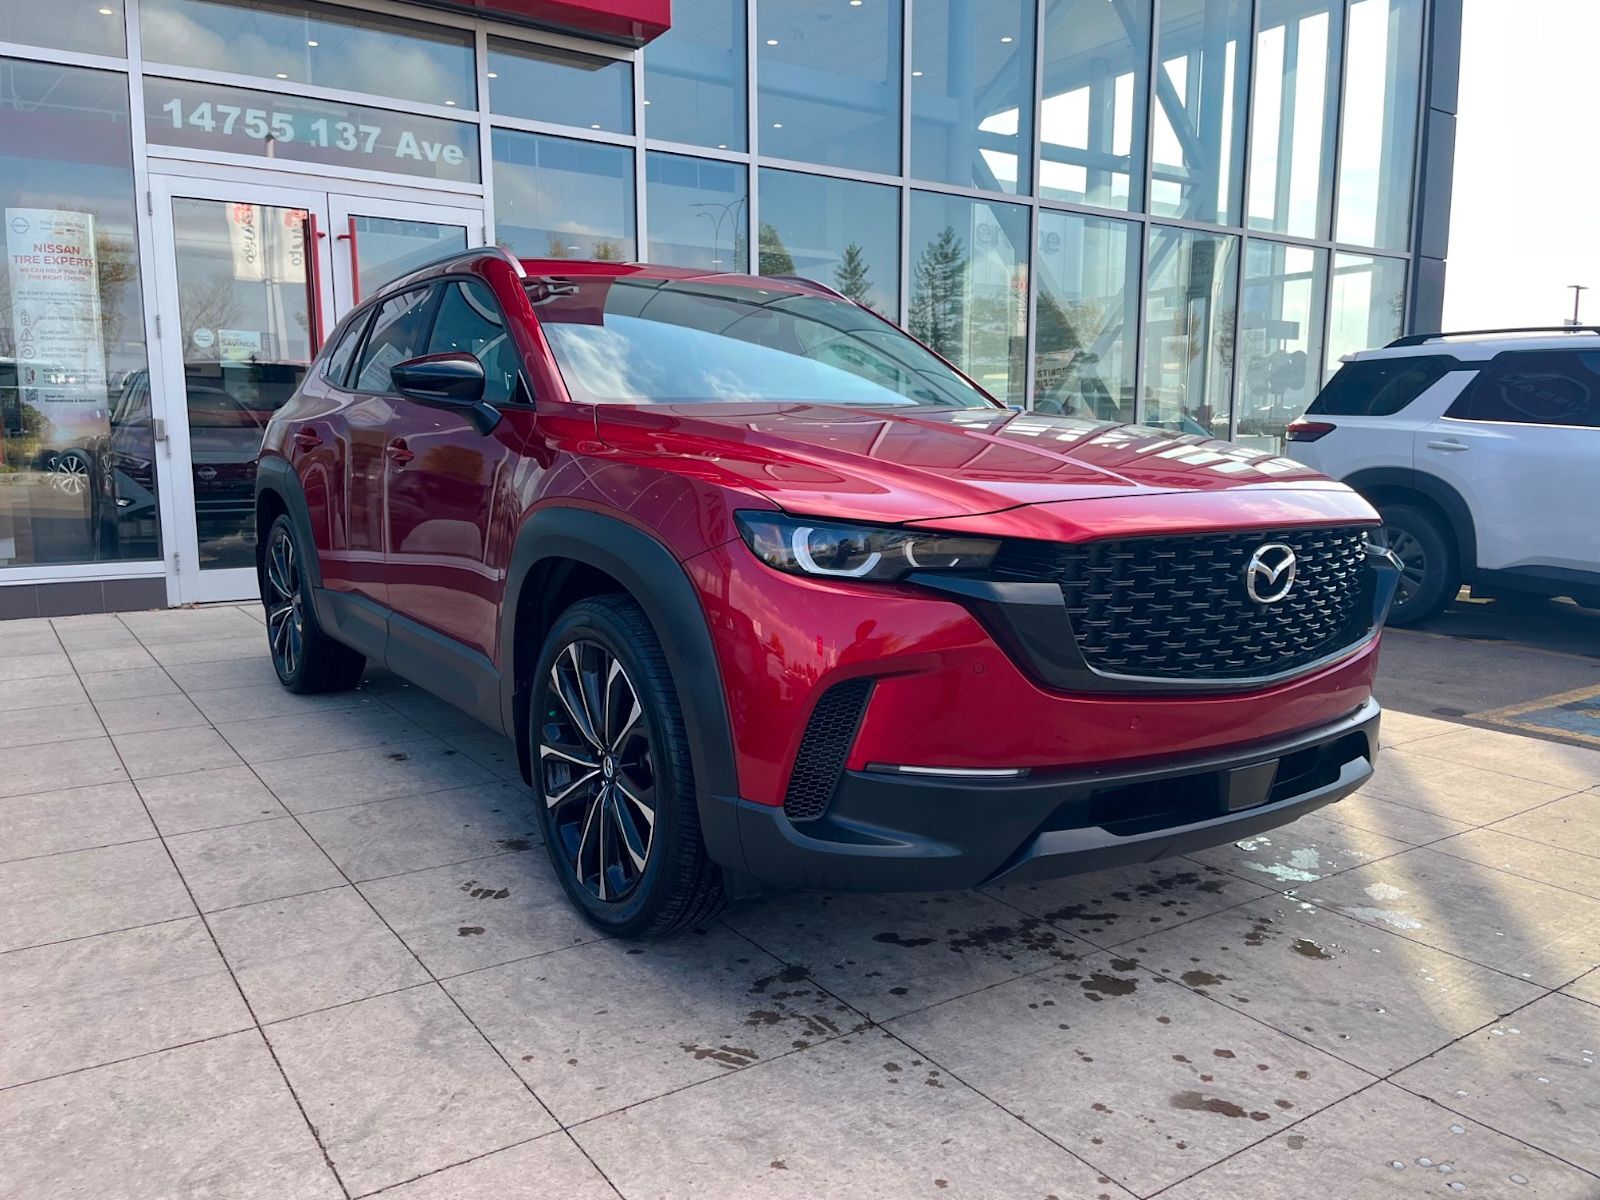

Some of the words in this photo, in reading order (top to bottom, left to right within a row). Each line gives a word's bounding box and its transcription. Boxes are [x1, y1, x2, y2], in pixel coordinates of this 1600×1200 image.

[162, 98, 295, 143] 14755
[310, 118, 382, 154] 137
[394, 131, 464, 165] Ave
[33, 244, 80, 254] NISSAN
[13, 255, 40, 264] TIRE
[44, 256, 94, 267] EXPERTS
